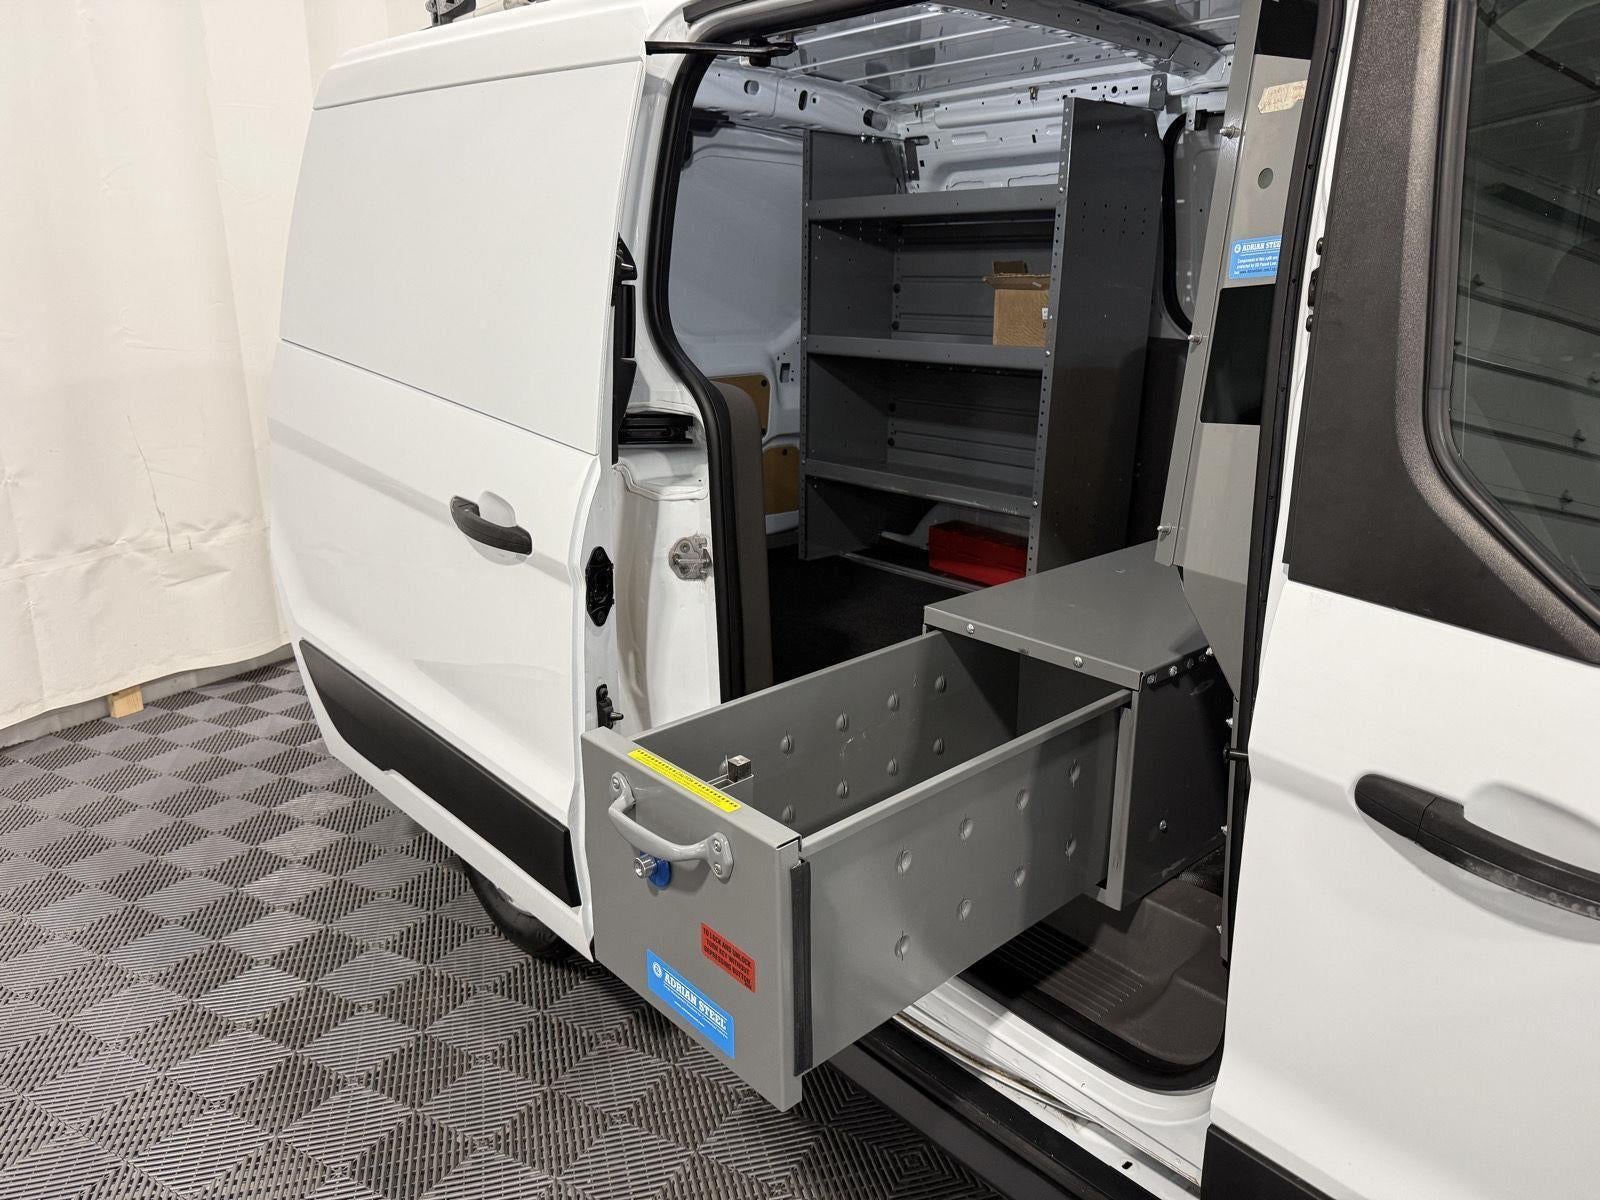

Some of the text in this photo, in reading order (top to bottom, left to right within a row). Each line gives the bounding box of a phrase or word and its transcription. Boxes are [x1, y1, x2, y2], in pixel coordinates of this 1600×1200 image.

[1242, 242, 1265, 251] ADRIAN
[703, 927, 753, 968] TO LOCK AND UNLOCK
[703, 945, 751, 985] DEPRESSING BUTTON
[706, 939, 750, 975] TURN KEY WITHOUT
[664, 971, 698, 1007] ADRIAN
[698, 1000, 728, 1031] STEEL
